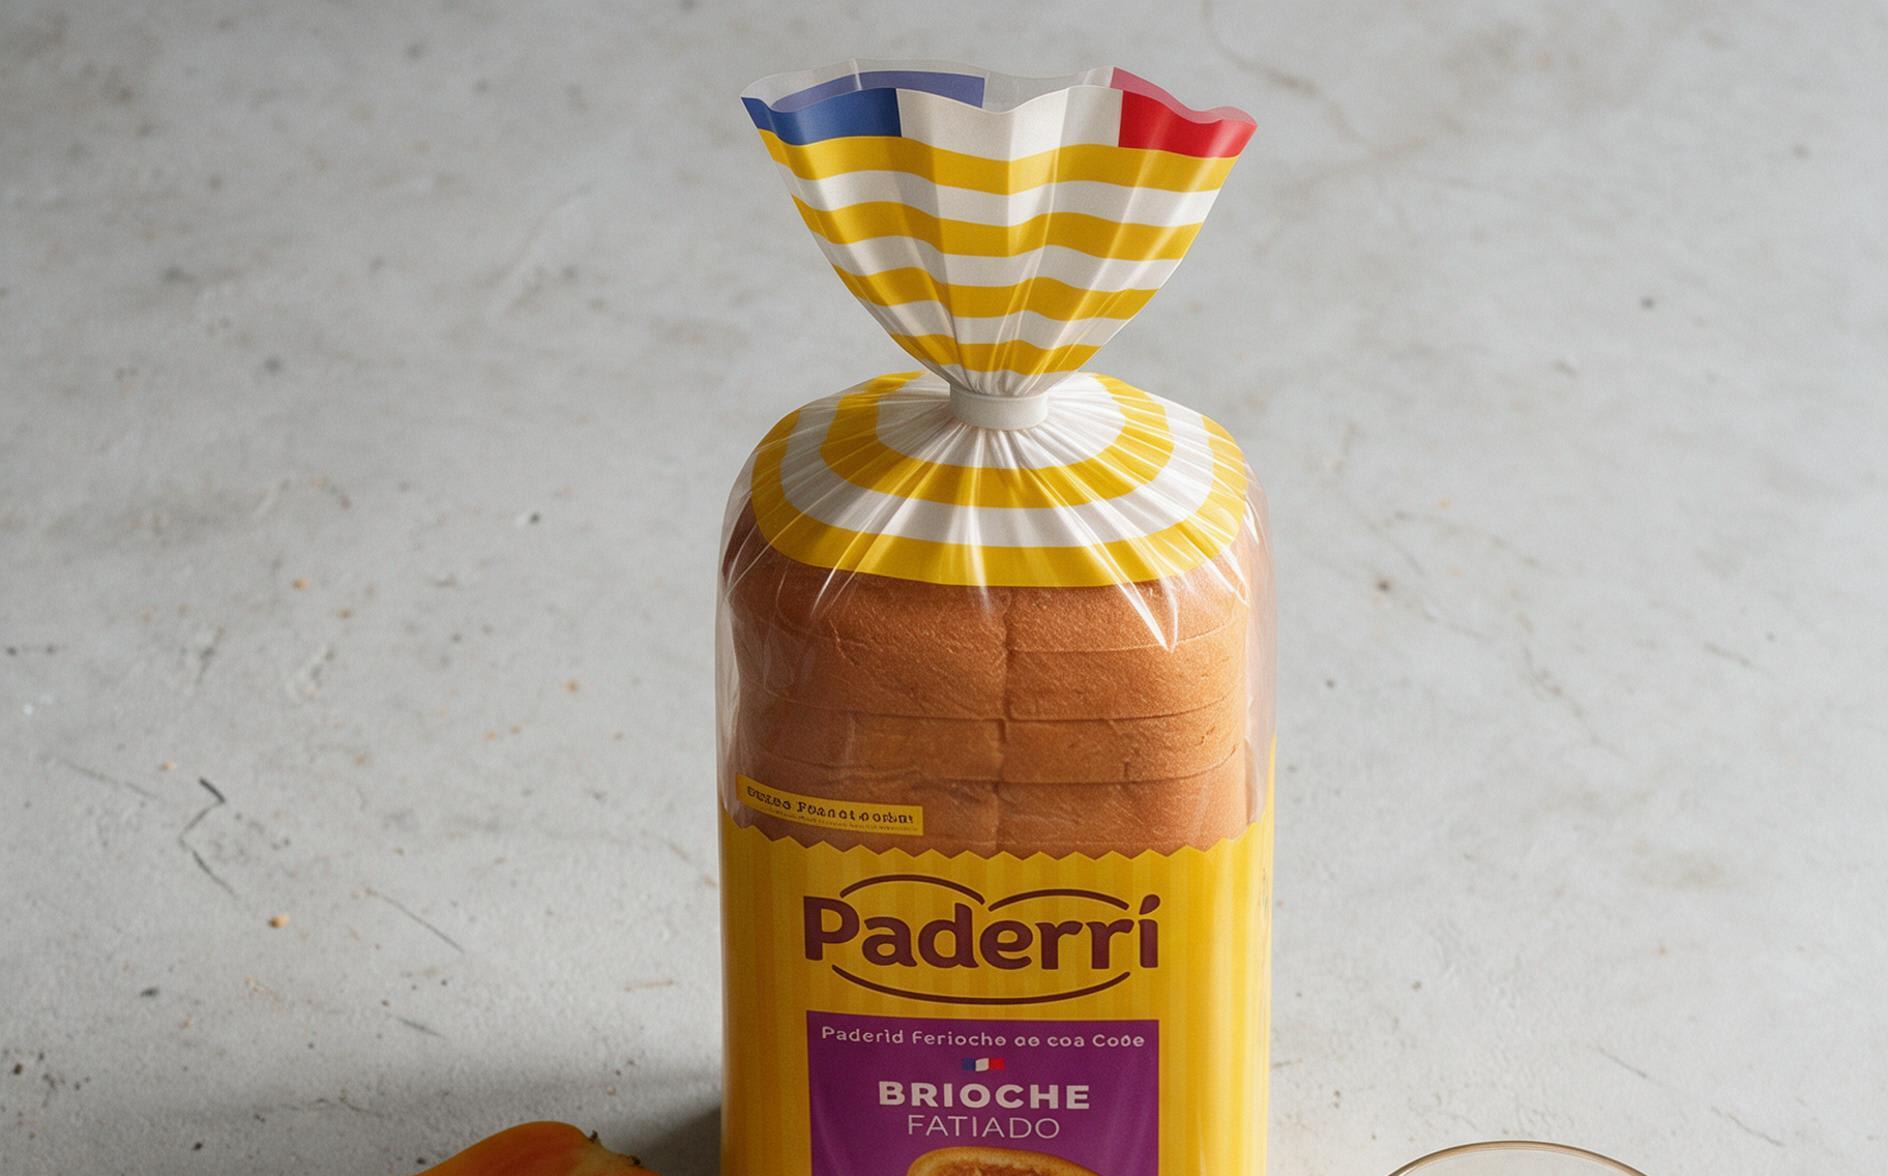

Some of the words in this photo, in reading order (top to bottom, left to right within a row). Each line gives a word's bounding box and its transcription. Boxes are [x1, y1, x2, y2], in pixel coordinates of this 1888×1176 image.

[803, 894, 1160, 970] Paderrí
[878, 1080, 1090, 1110] BRIOCHE
[908, 1114, 1060, 1140] FATIADO
